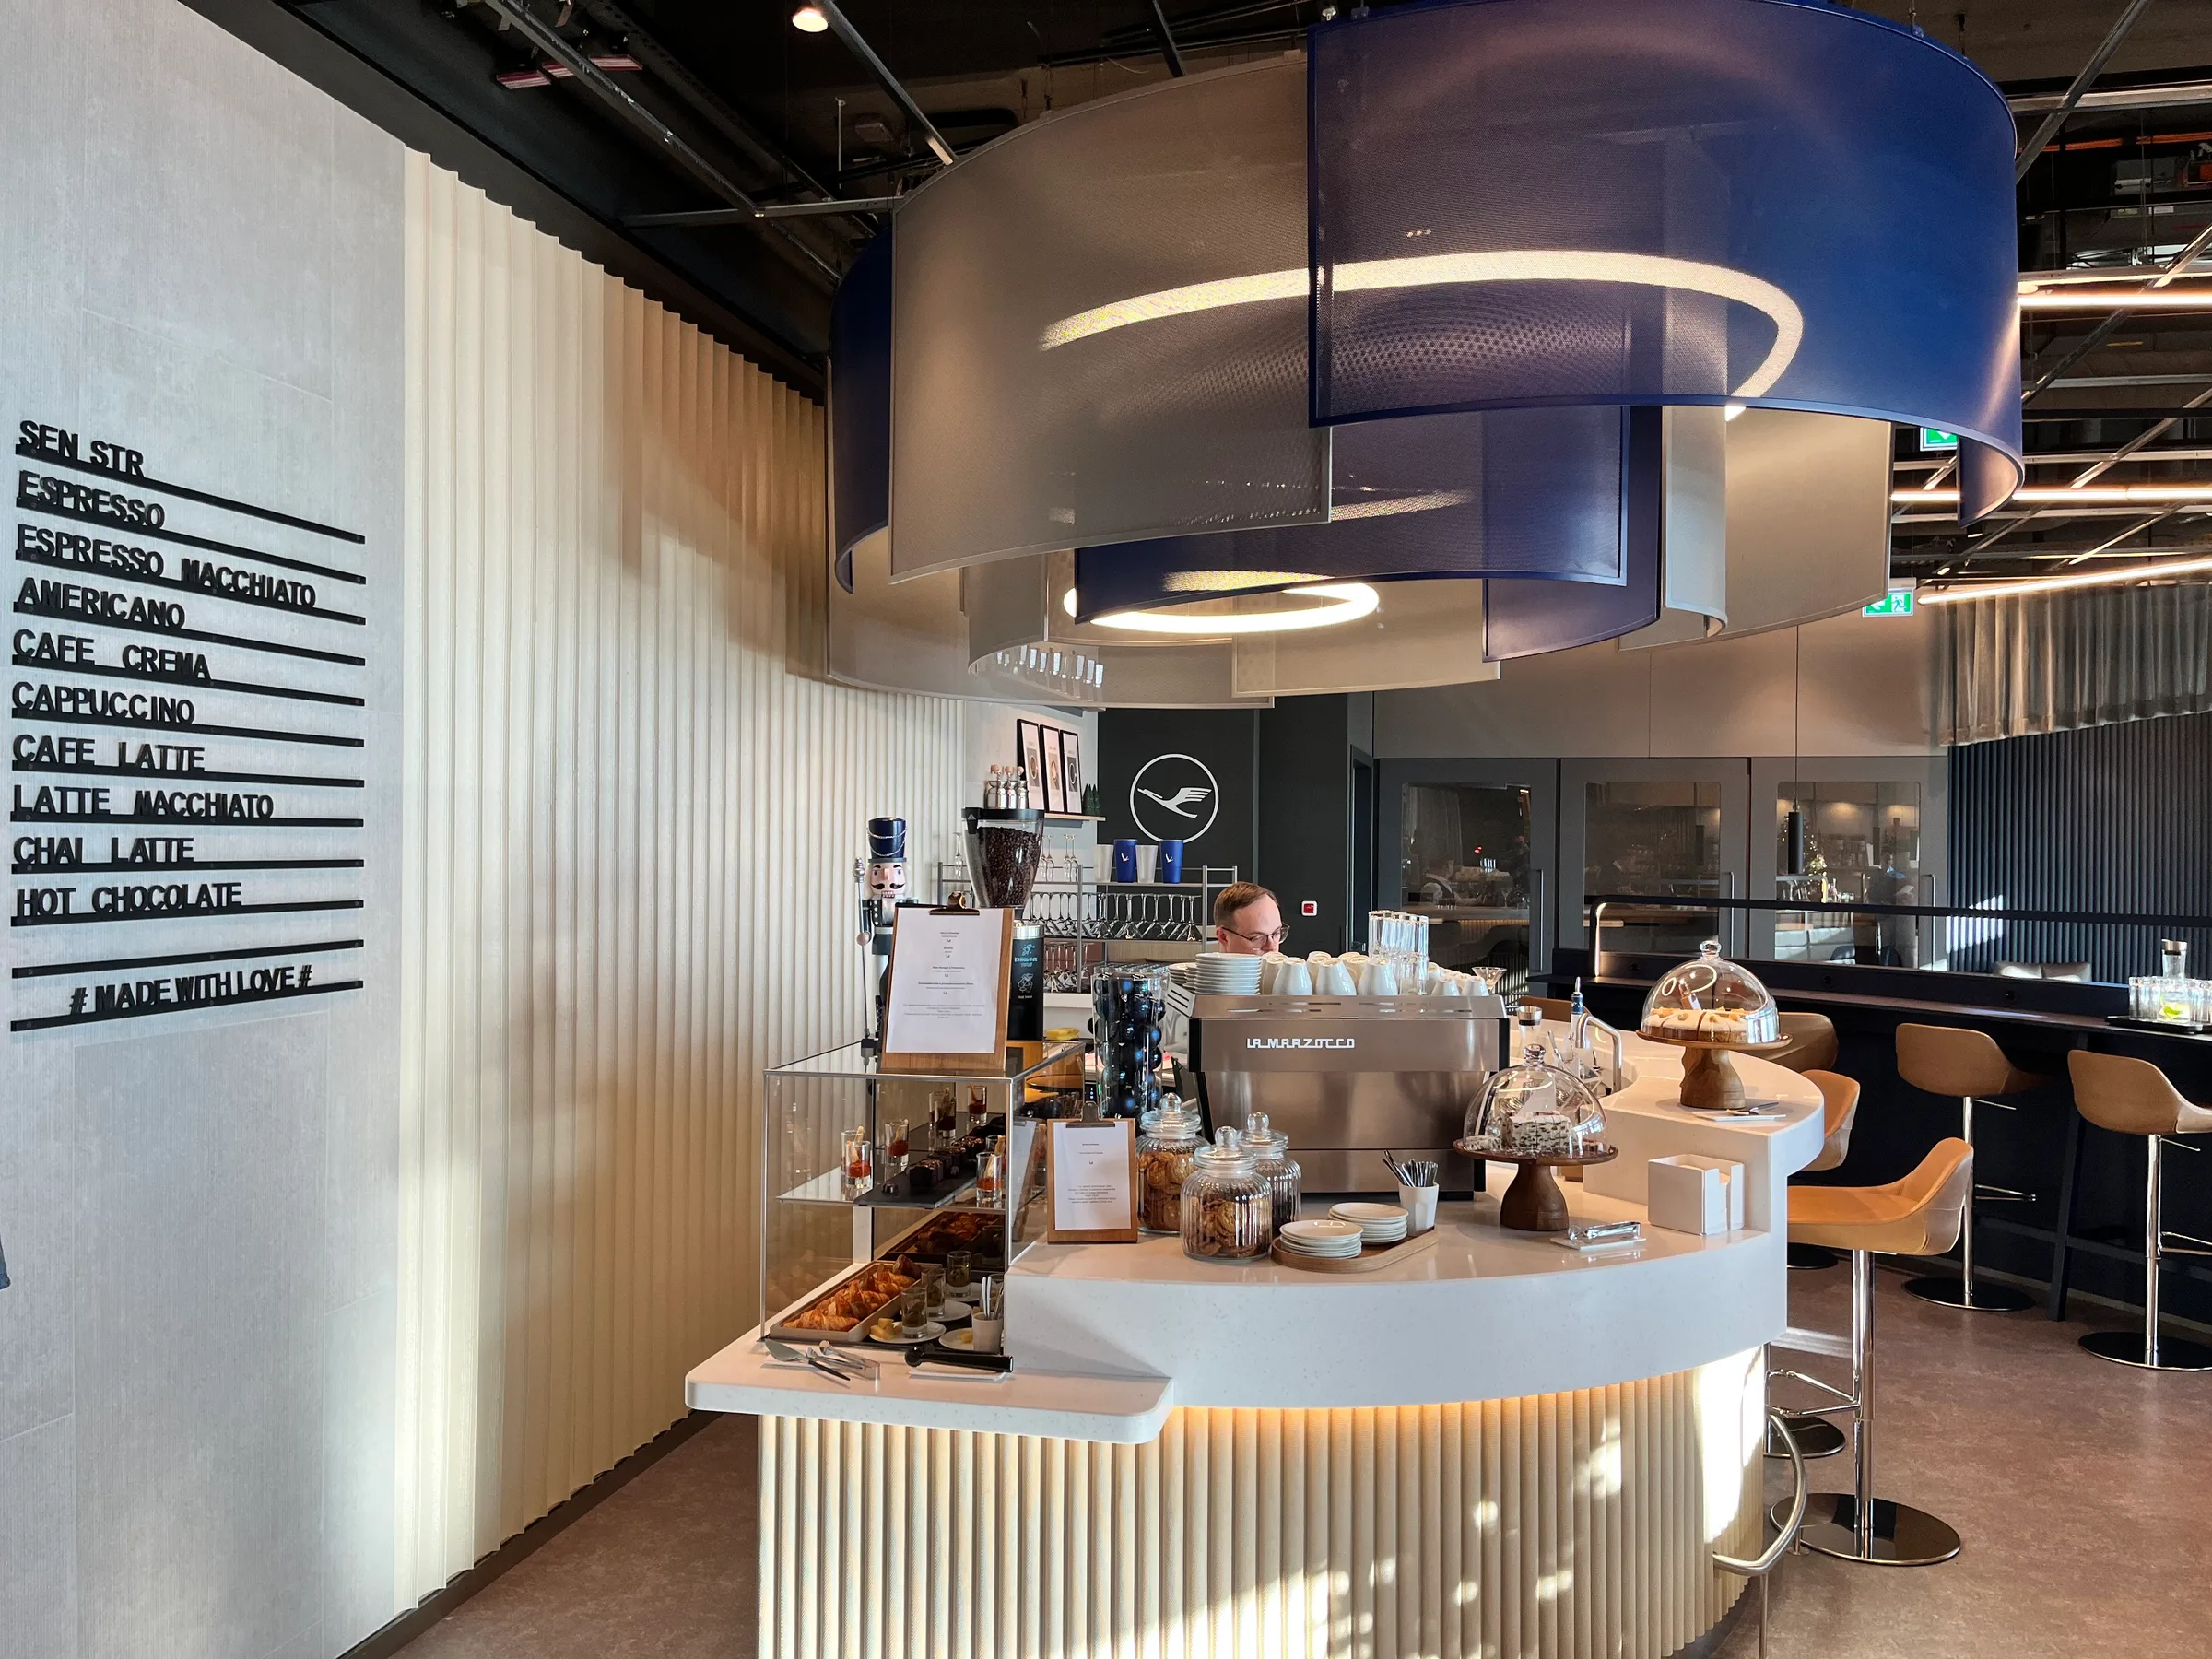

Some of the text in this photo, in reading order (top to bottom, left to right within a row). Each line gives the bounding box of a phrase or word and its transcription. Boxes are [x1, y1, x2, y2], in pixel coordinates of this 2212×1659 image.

[19, 420, 145, 477] SEN STR
[18, 471, 165, 528] ESPRESSO
[18, 524, 316, 608] ESPRESSO MACCHIATO
[17, 577, 185, 629] AMERICANO
[13, 629, 212, 680] CAFE CREMA
[12, 682, 194, 724] CAPPUCCINO
[13, 735, 205, 771] CAFE LATTE
[14, 784, 274, 818] LATTE MACCHIATO
[14, 837, 194, 864] CHAI LATTE
[17, 882, 241, 916] HOT CHOCOLATE
